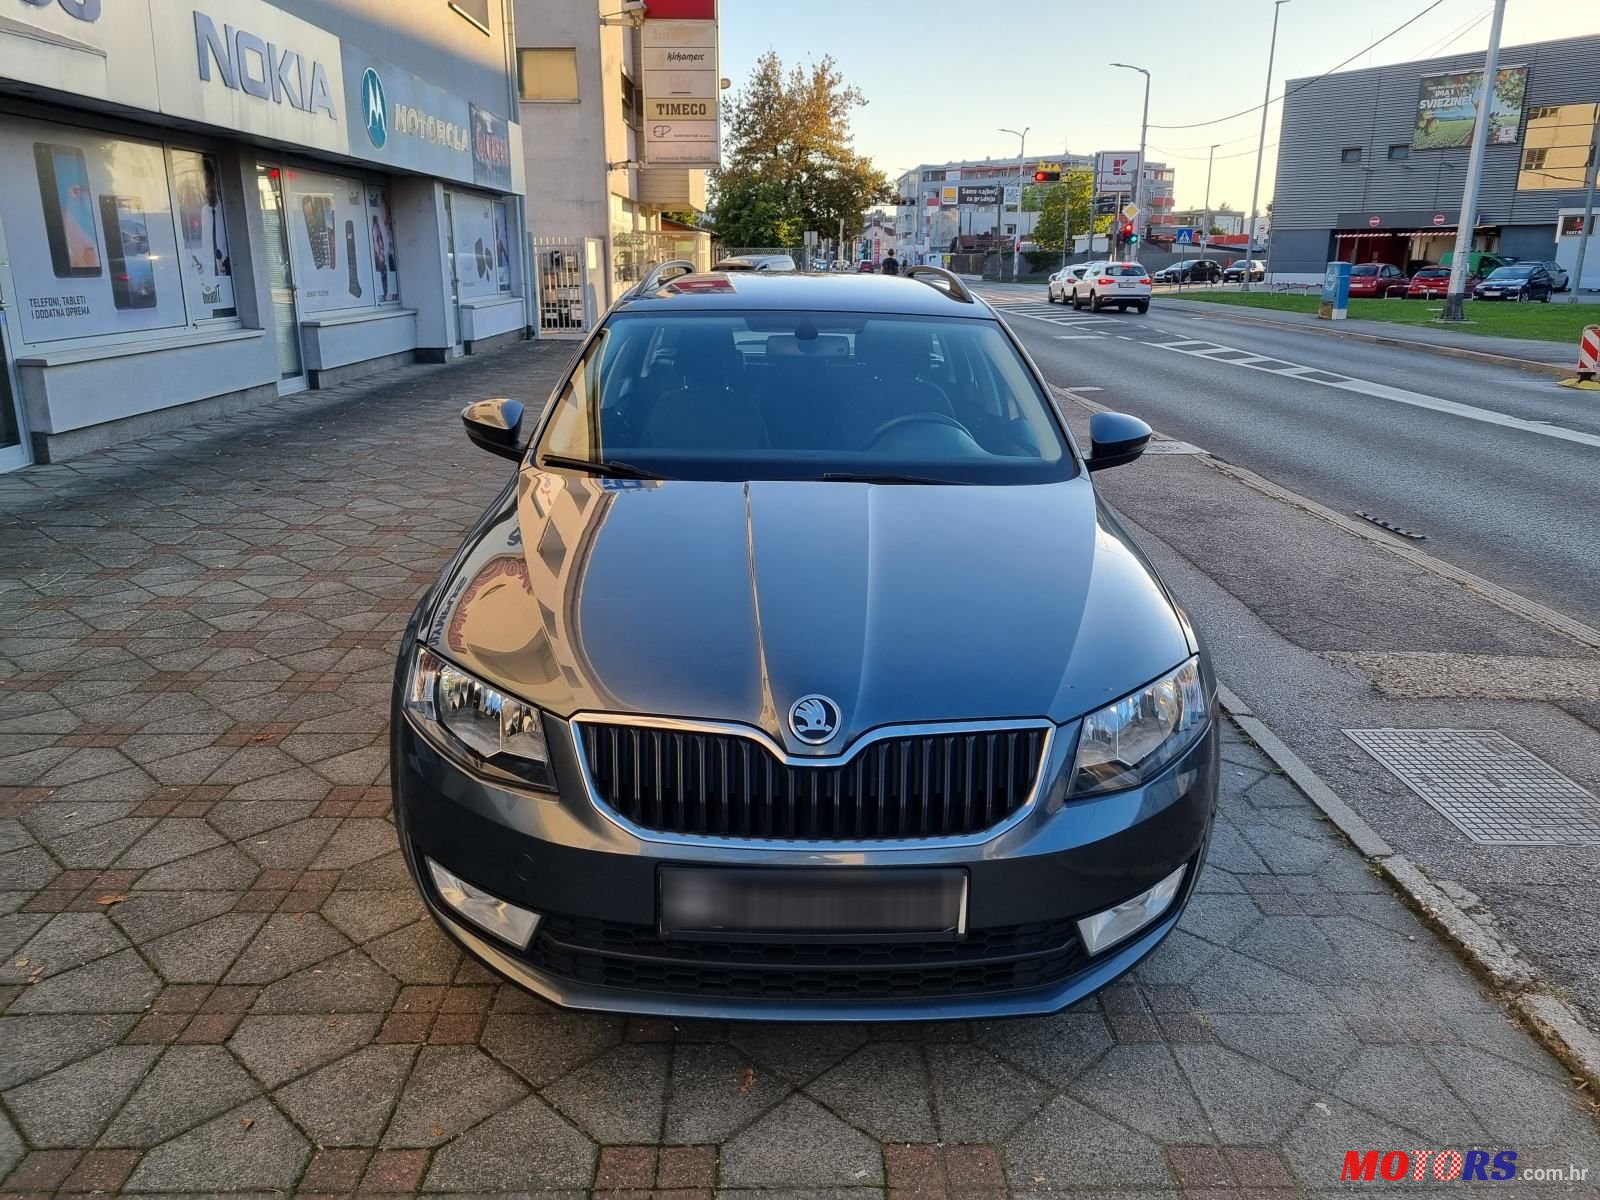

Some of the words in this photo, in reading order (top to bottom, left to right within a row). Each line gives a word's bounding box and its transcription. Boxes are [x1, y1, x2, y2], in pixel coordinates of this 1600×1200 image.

[193, 10, 337, 121] NOKIA
[656, 103, 707, 116] TIMECO
[394, 103, 469, 152] MOTOROLA
[961, 187, 977, 195] Samo
[28, 297, 62, 308] TELEFONI,
[61, 295, 87, 305] TABLETI
[35, 308, 66, 319] DODATNA
[65, 306, 91, 317] OPREMA
